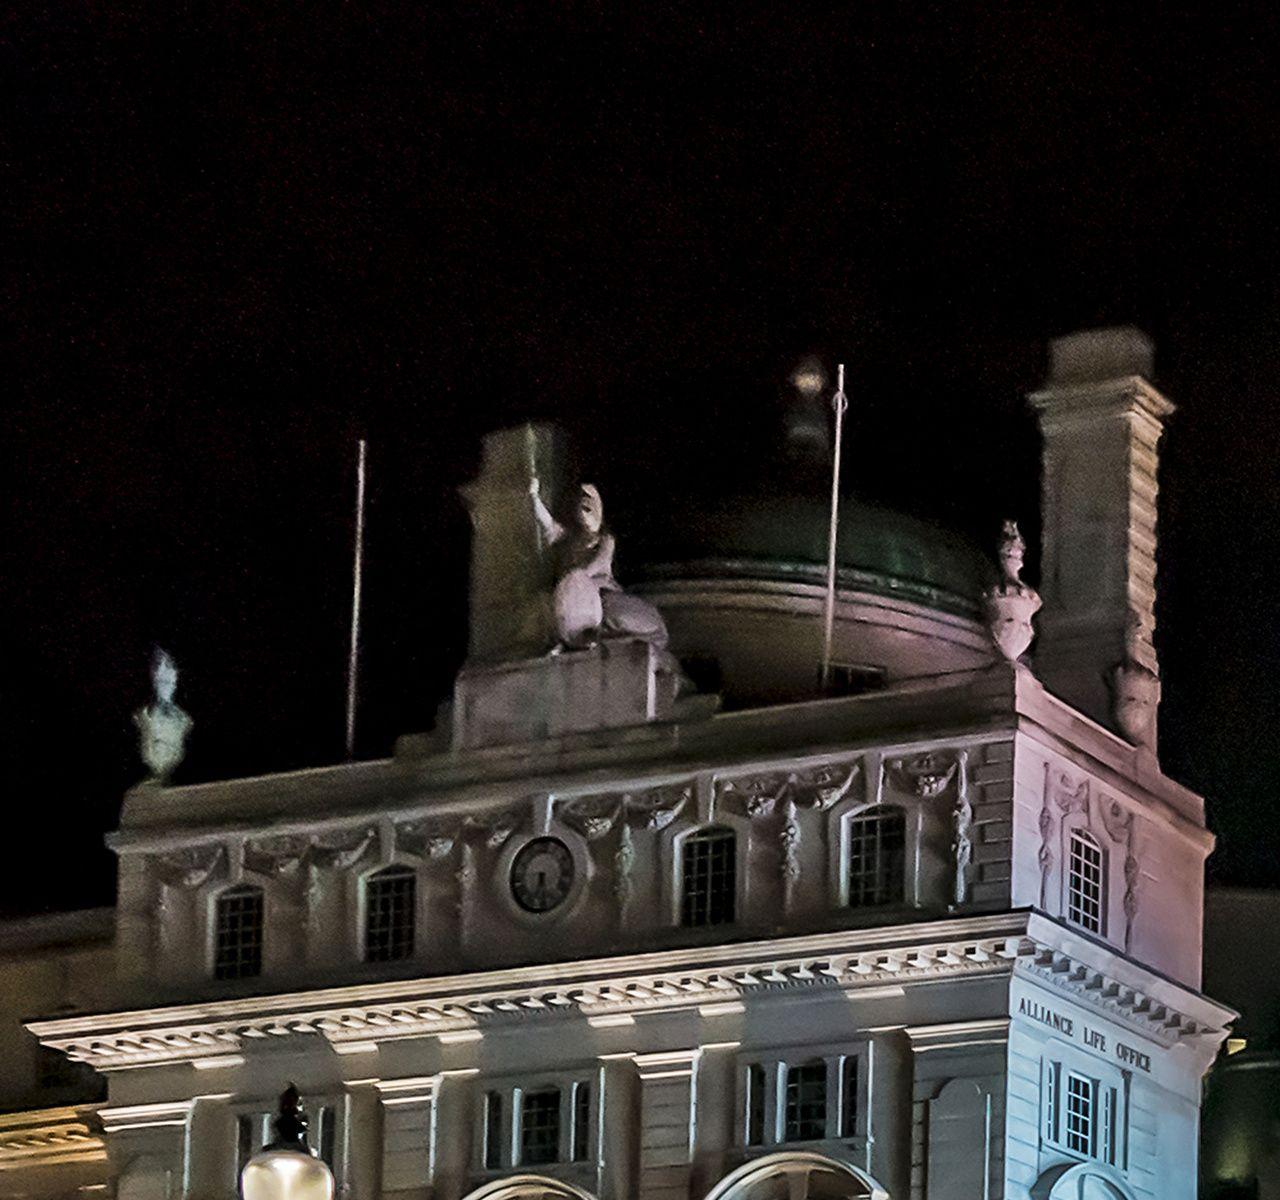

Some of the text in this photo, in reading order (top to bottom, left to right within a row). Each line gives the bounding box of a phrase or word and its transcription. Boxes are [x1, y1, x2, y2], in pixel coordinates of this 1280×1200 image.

[1020, 998, 1151, 1073] ALLIANCE LIFE OFFICE
